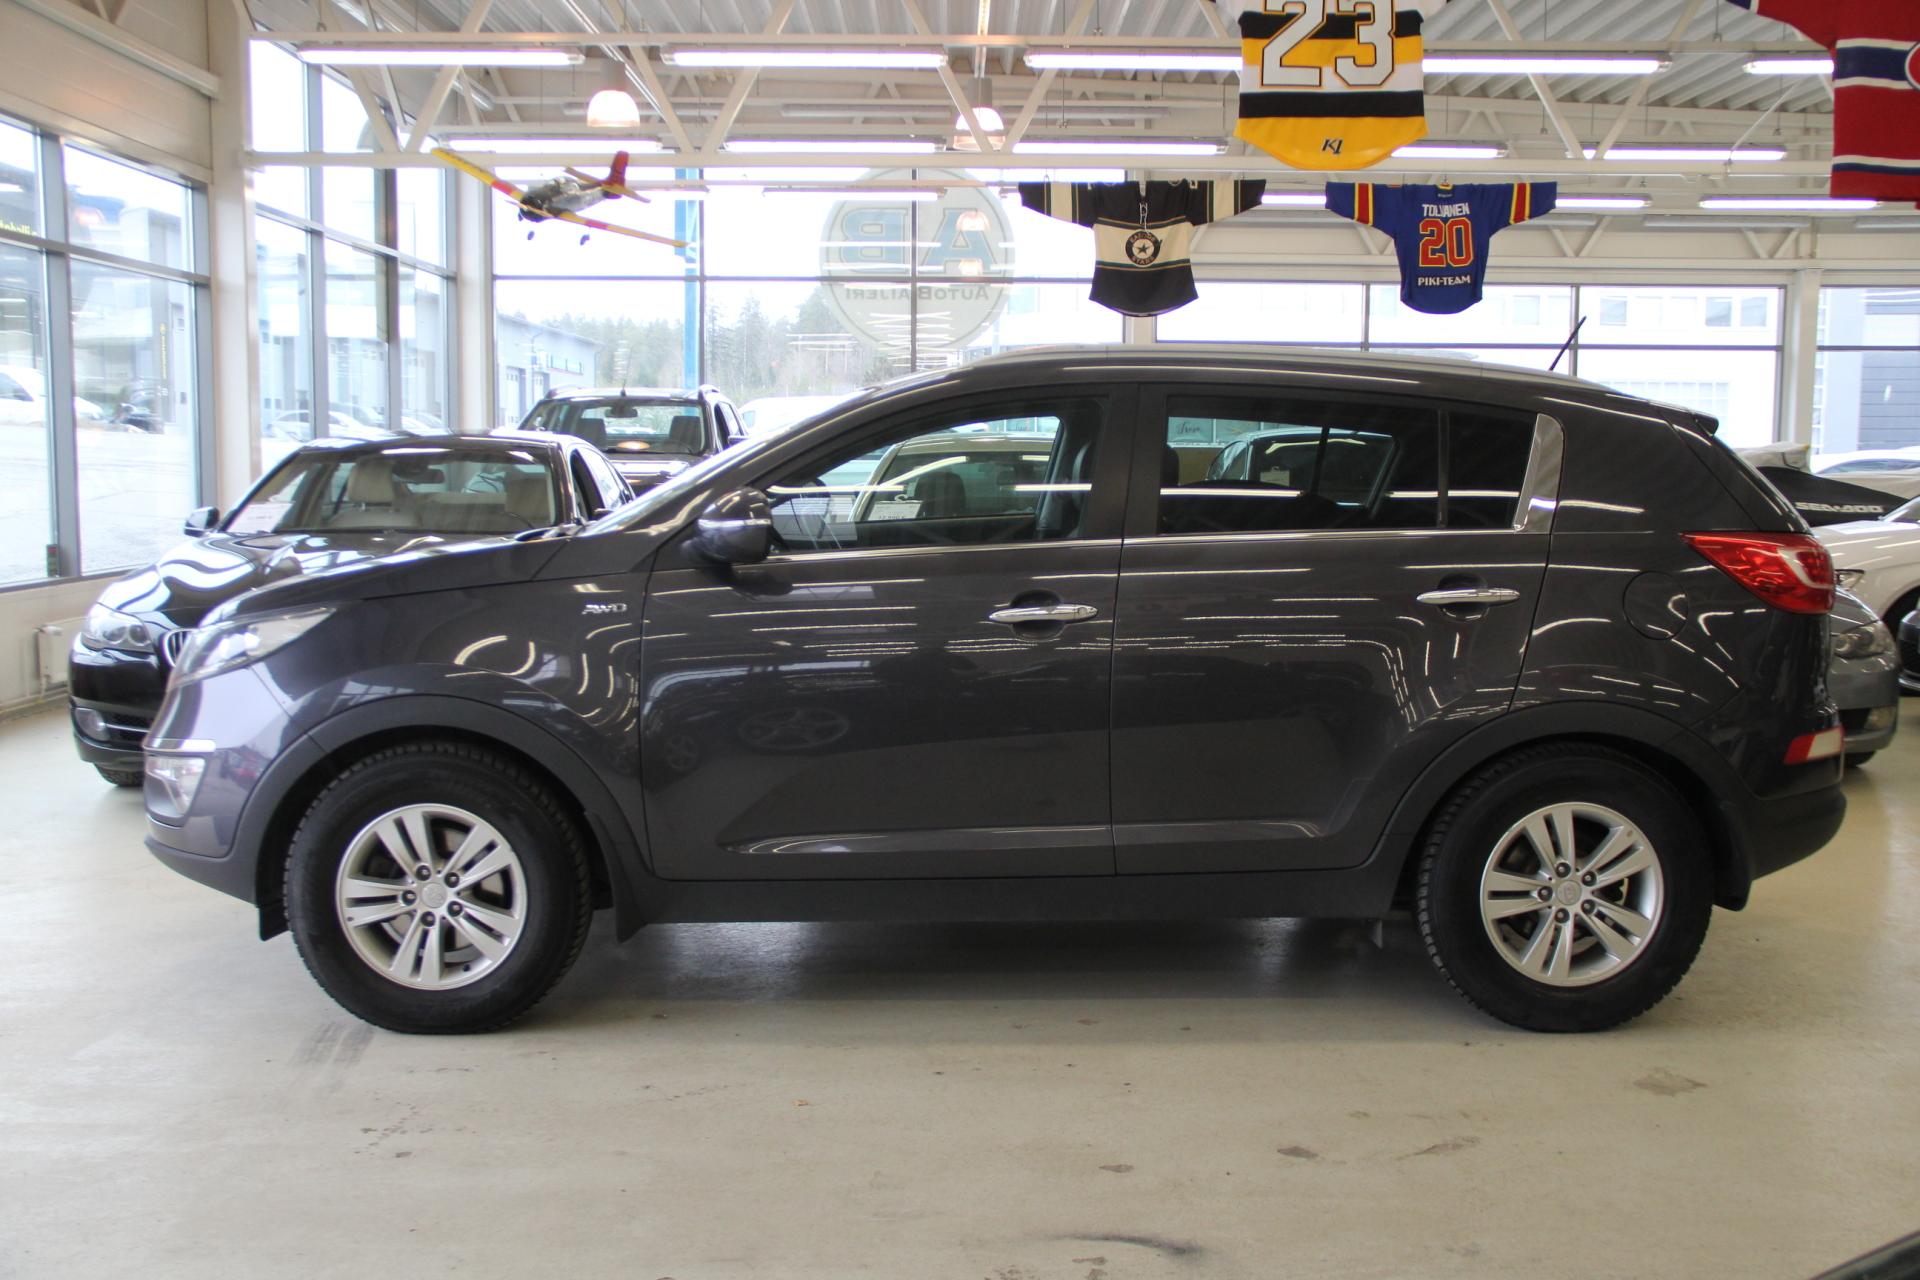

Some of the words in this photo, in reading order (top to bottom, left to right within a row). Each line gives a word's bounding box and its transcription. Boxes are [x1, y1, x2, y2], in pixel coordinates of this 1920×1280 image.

[1260, 0, 1395, 88] 23
[1421, 202, 1470, 217] TOLVANEN
[1418, 217, 1473, 267] 20
[1417, 275, 1471, 286] PIKI-TEAM
